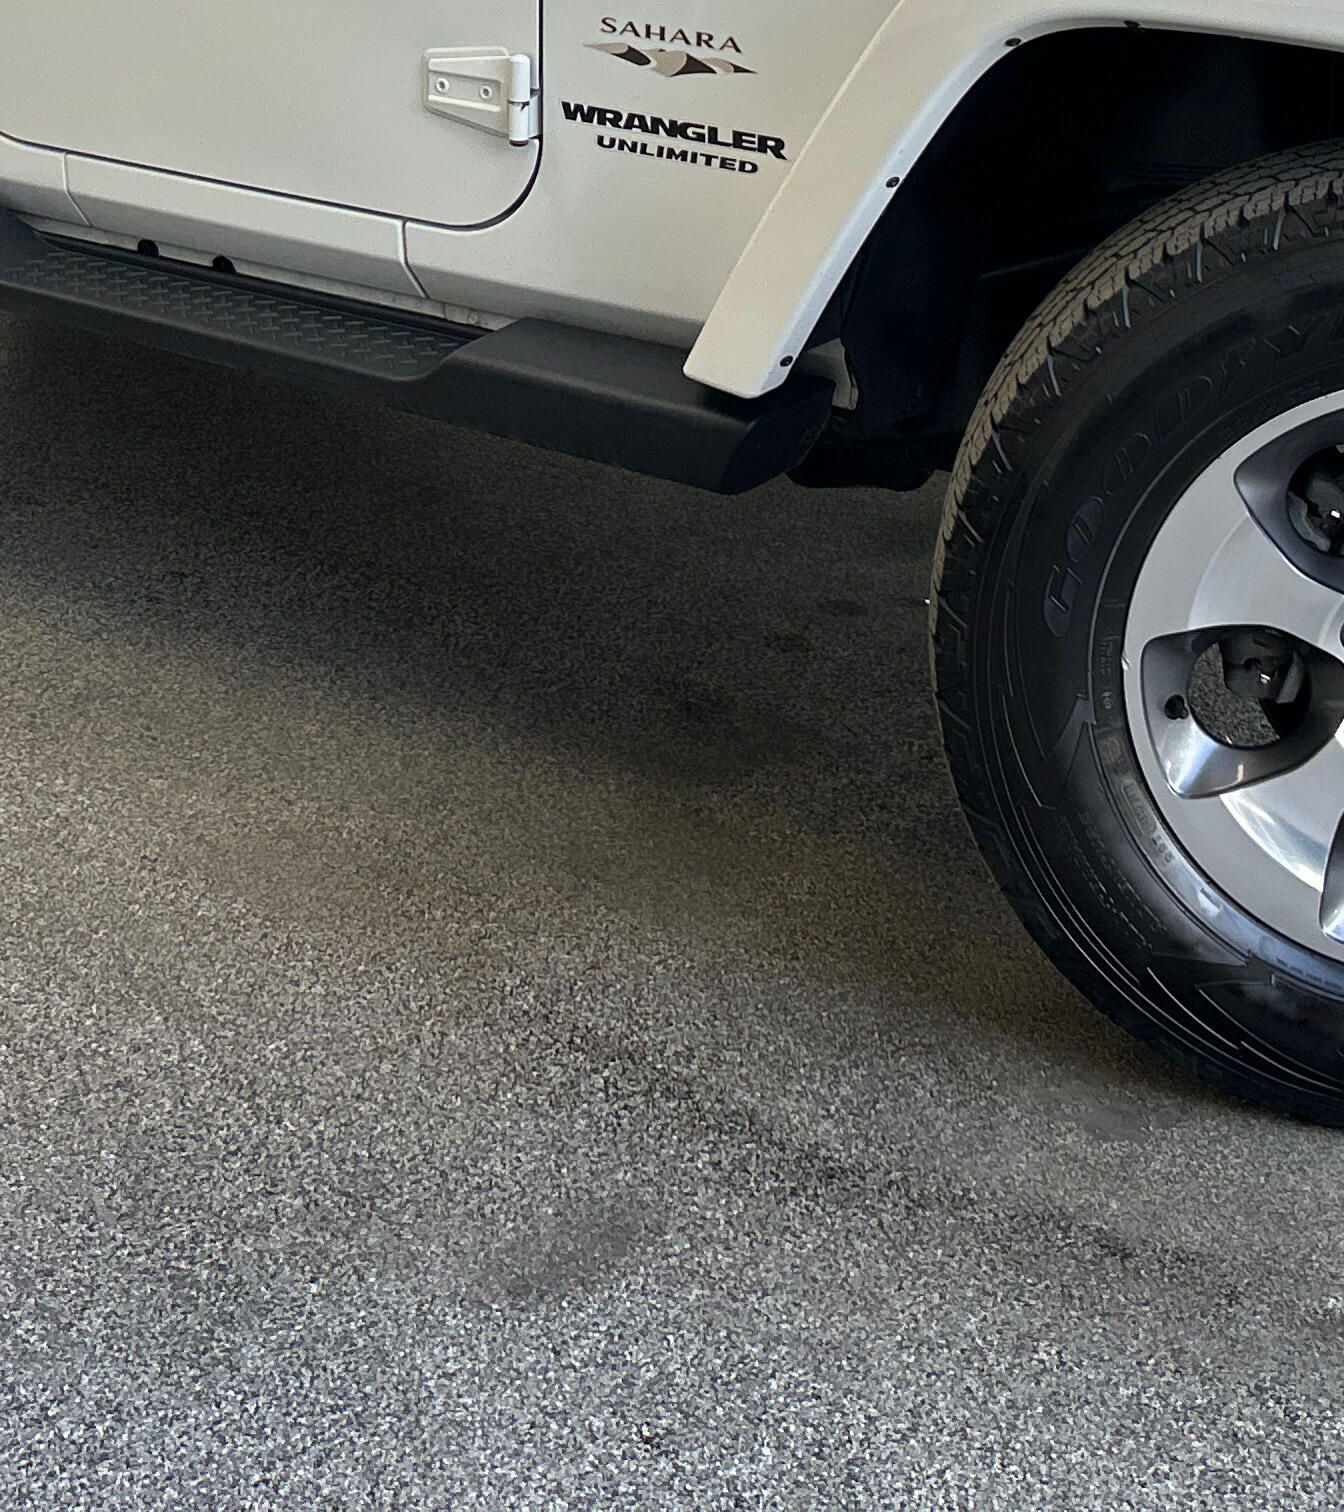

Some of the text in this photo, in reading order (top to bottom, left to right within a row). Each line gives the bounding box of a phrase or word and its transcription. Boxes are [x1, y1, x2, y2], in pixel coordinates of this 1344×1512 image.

[600, 16, 744, 54] SAHARA
[561, 101, 788, 161] WRANGLER
[596, 134, 759, 174] UNLIMITED
